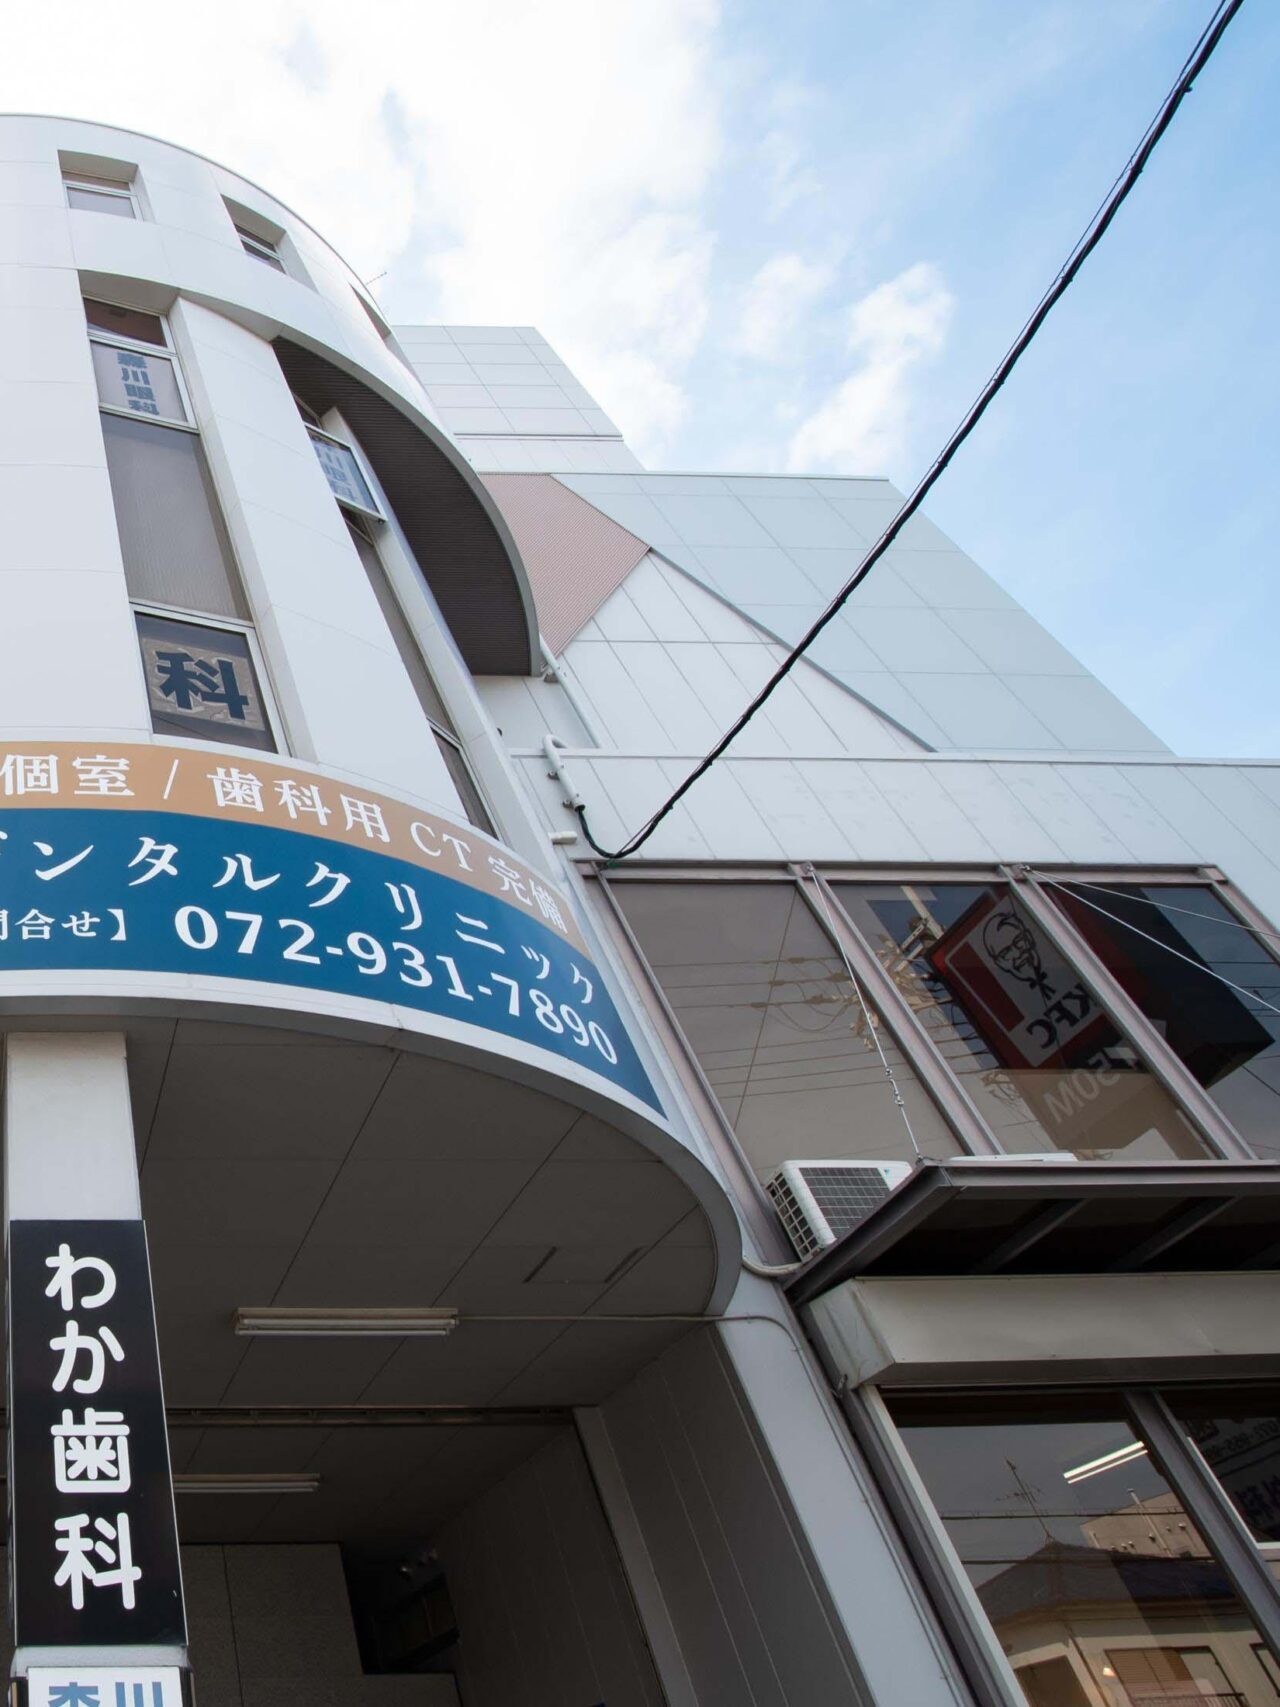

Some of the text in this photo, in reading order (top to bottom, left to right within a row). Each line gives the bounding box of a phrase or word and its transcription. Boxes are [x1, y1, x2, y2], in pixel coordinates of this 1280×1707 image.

[155, 650, 250, 720] 科
[173, 904, 618, 1065] 072-931-7890
[45, 1243, 142, 1610] わか歯科
